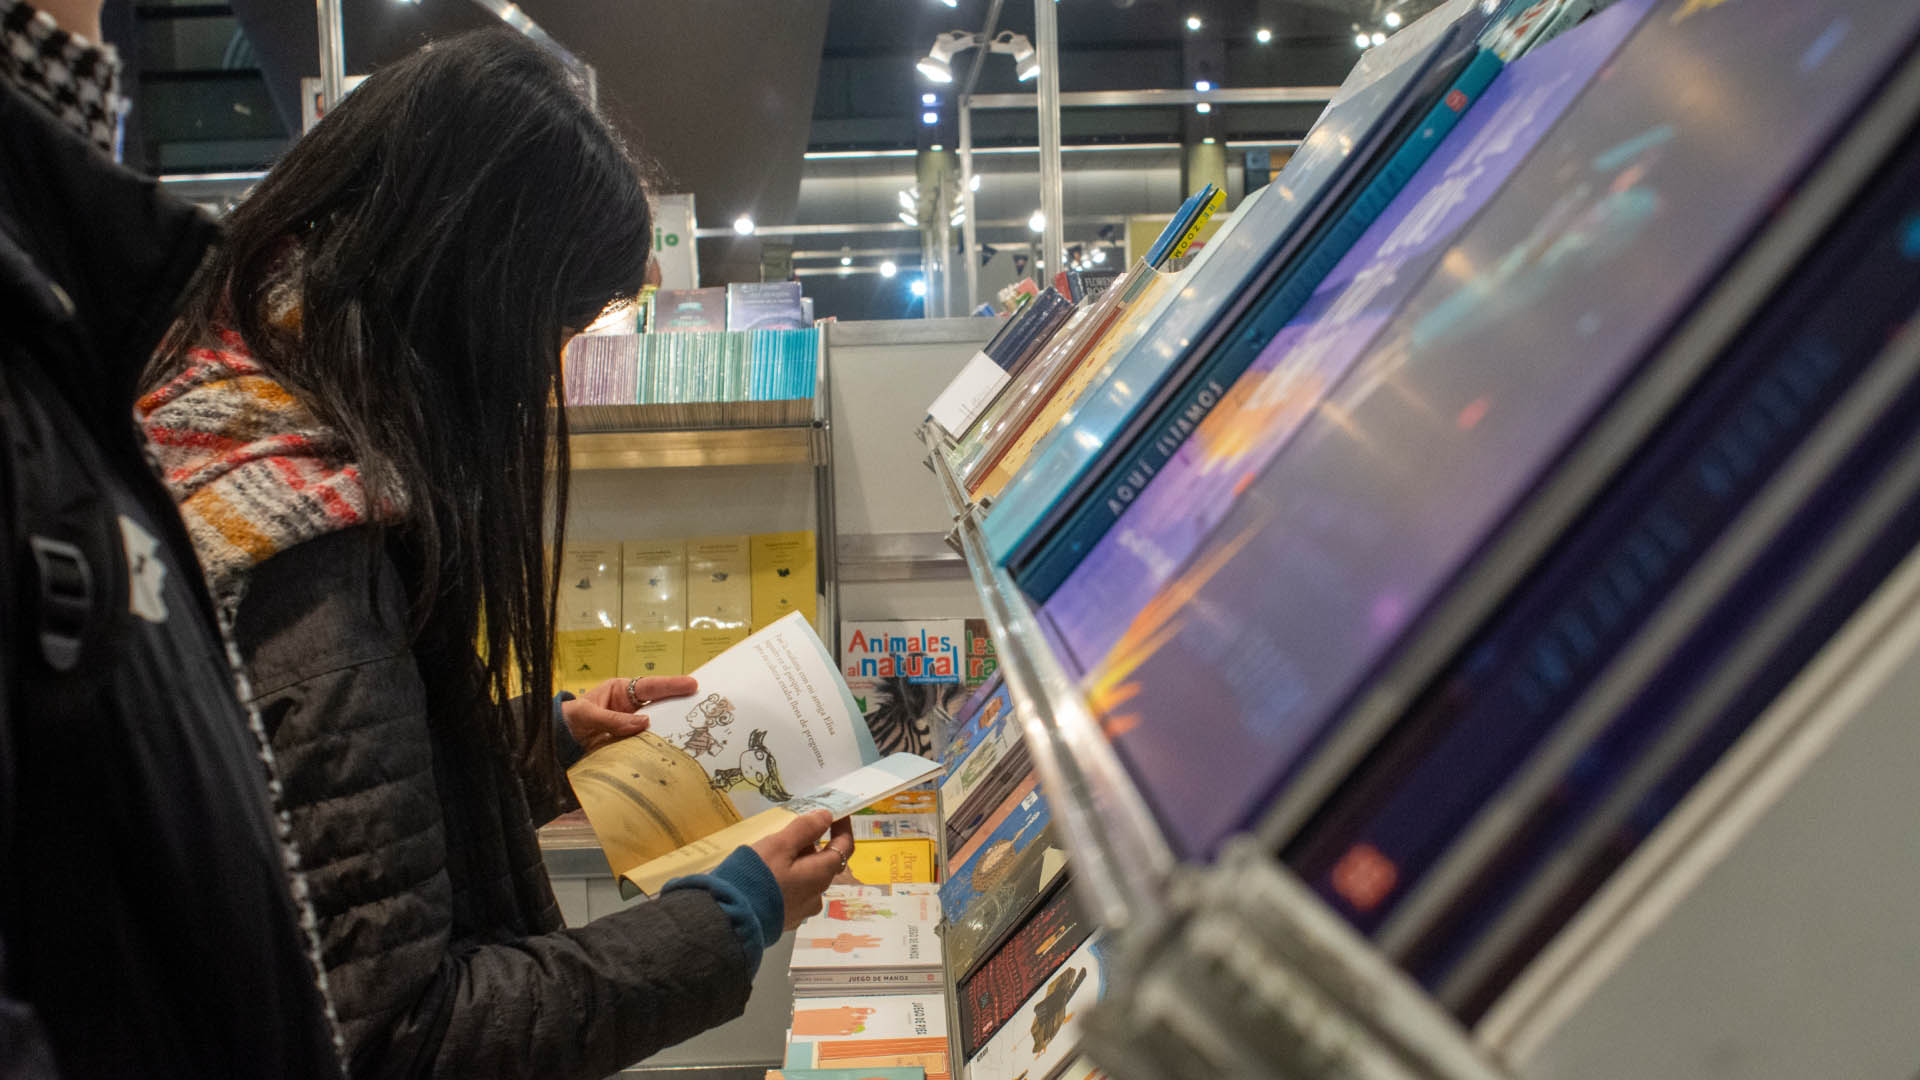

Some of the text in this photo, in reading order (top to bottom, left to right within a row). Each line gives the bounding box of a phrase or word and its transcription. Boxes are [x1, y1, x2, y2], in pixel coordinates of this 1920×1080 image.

[848, 629, 952, 653] Animales
[847, 645, 959, 677] al natural
[848, 975, 871, 983] JUEGO
